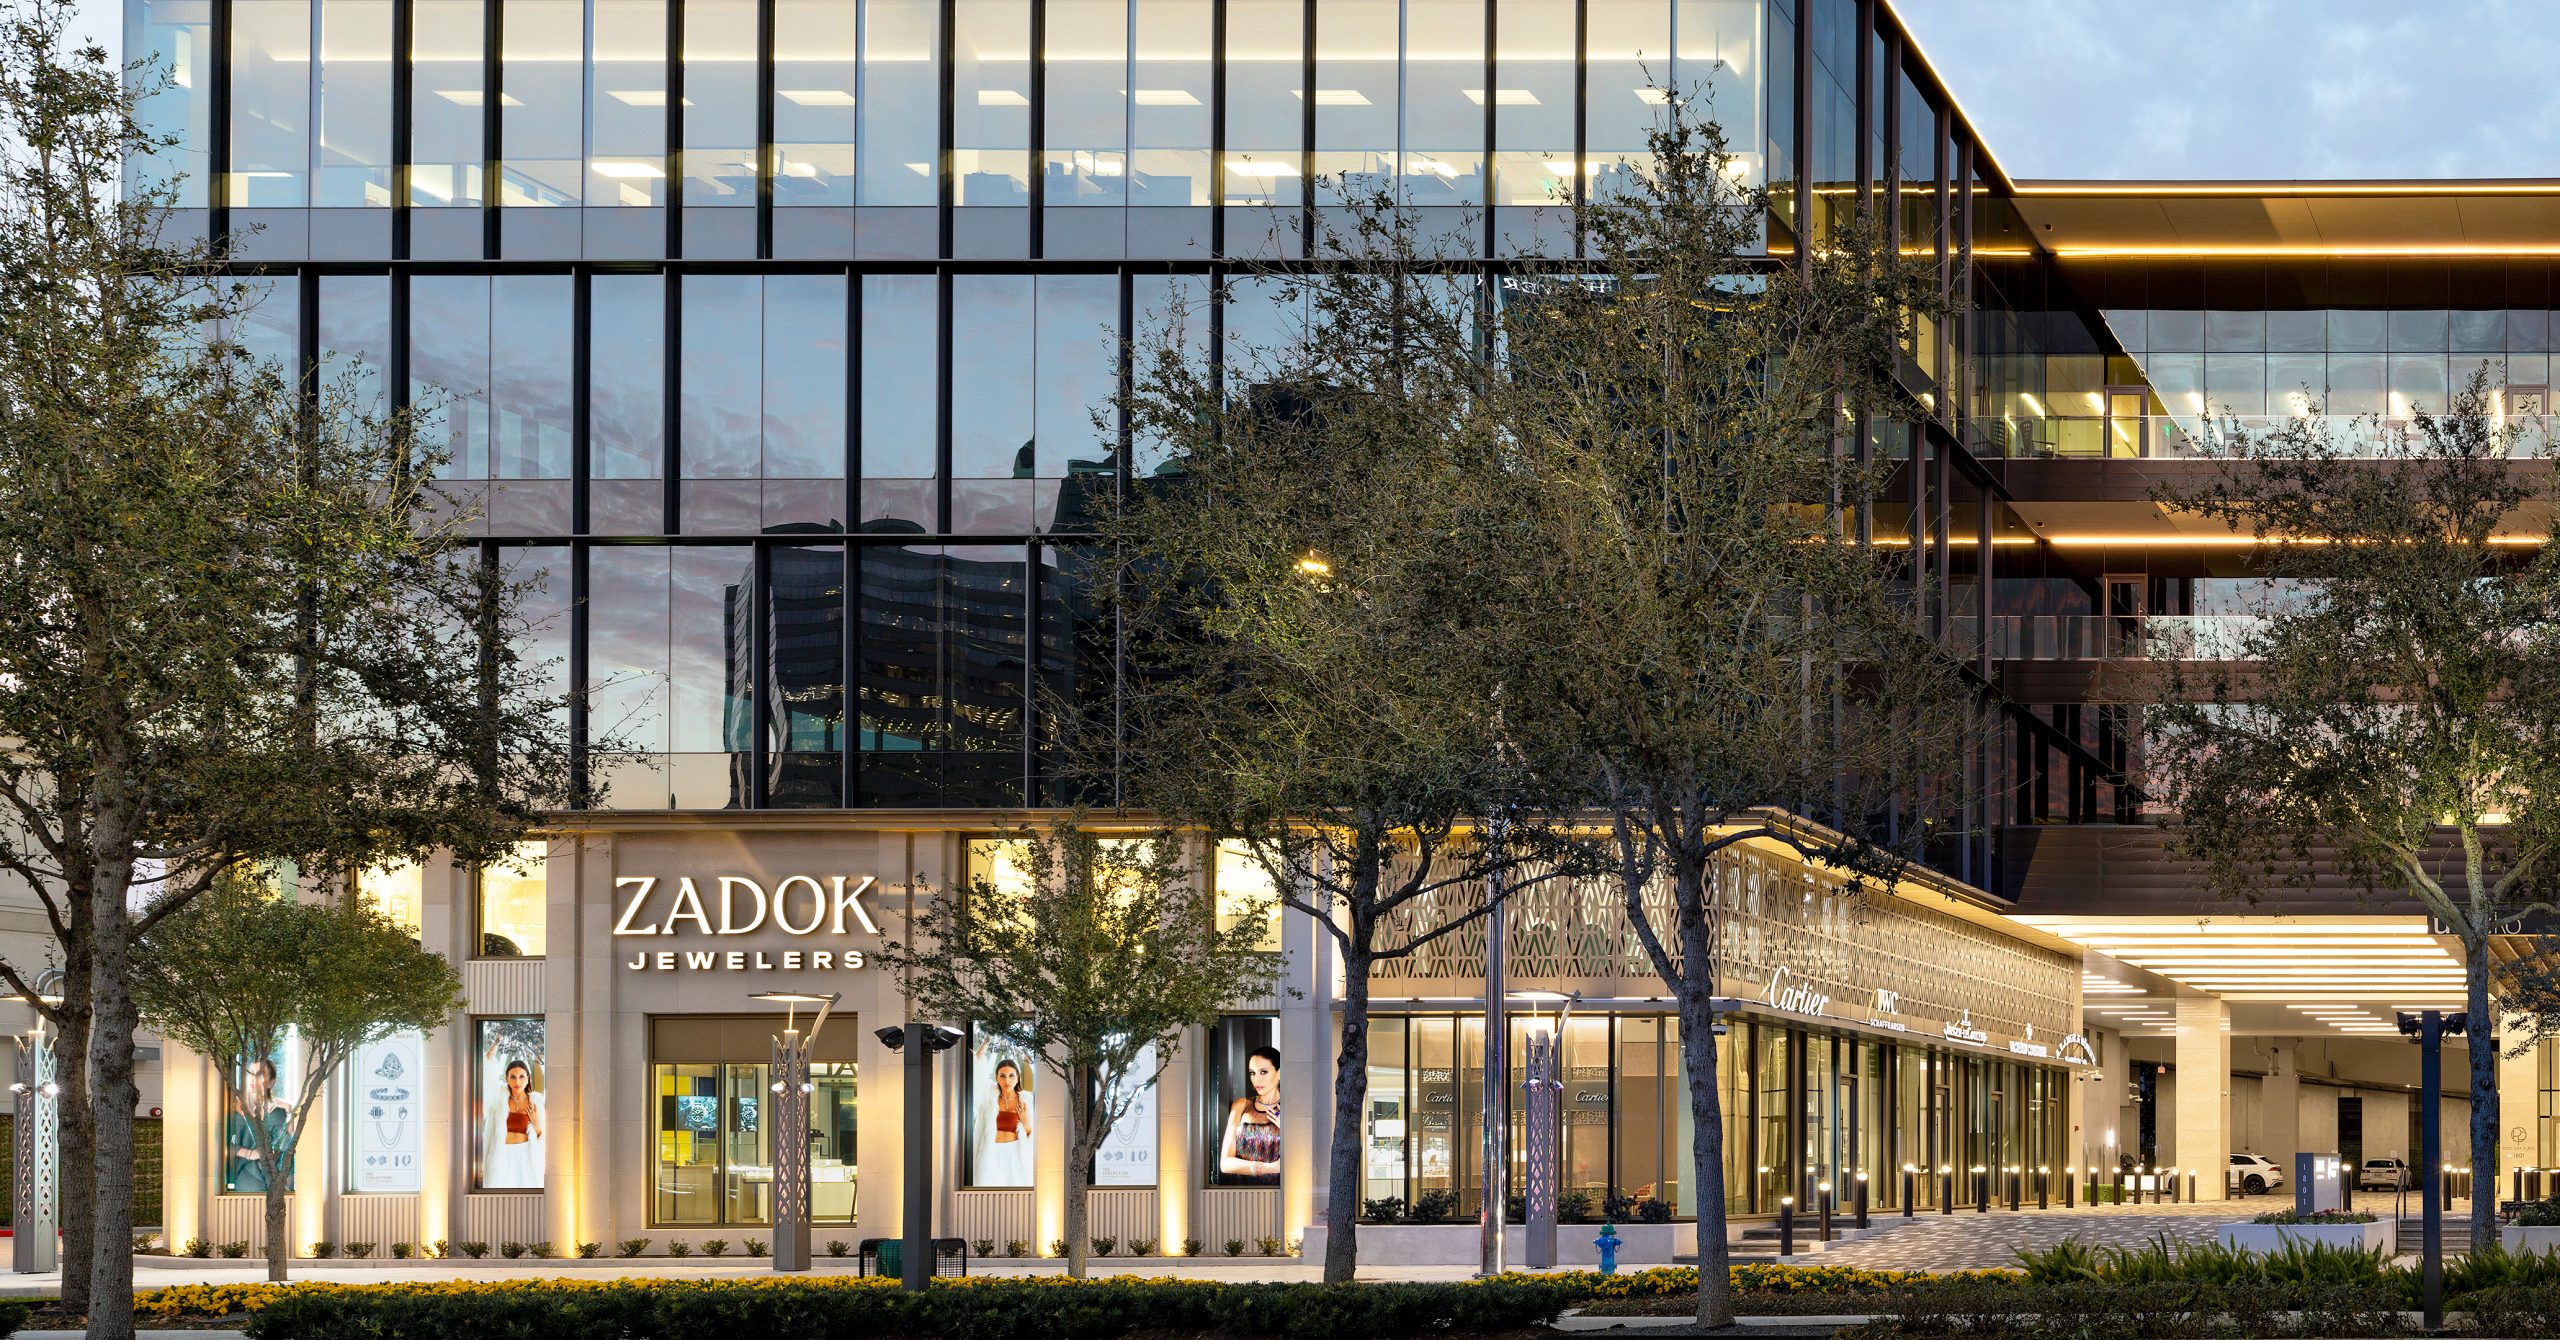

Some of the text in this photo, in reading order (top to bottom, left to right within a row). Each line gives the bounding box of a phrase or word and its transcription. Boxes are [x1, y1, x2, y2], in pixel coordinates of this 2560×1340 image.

[613, 875, 879, 936] ZADOK
[628, 950, 867, 971] JEWELERS
[1770, 965, 1829, 1017] Cartier
[1425, 1091, 1454, 1103] Cartie
